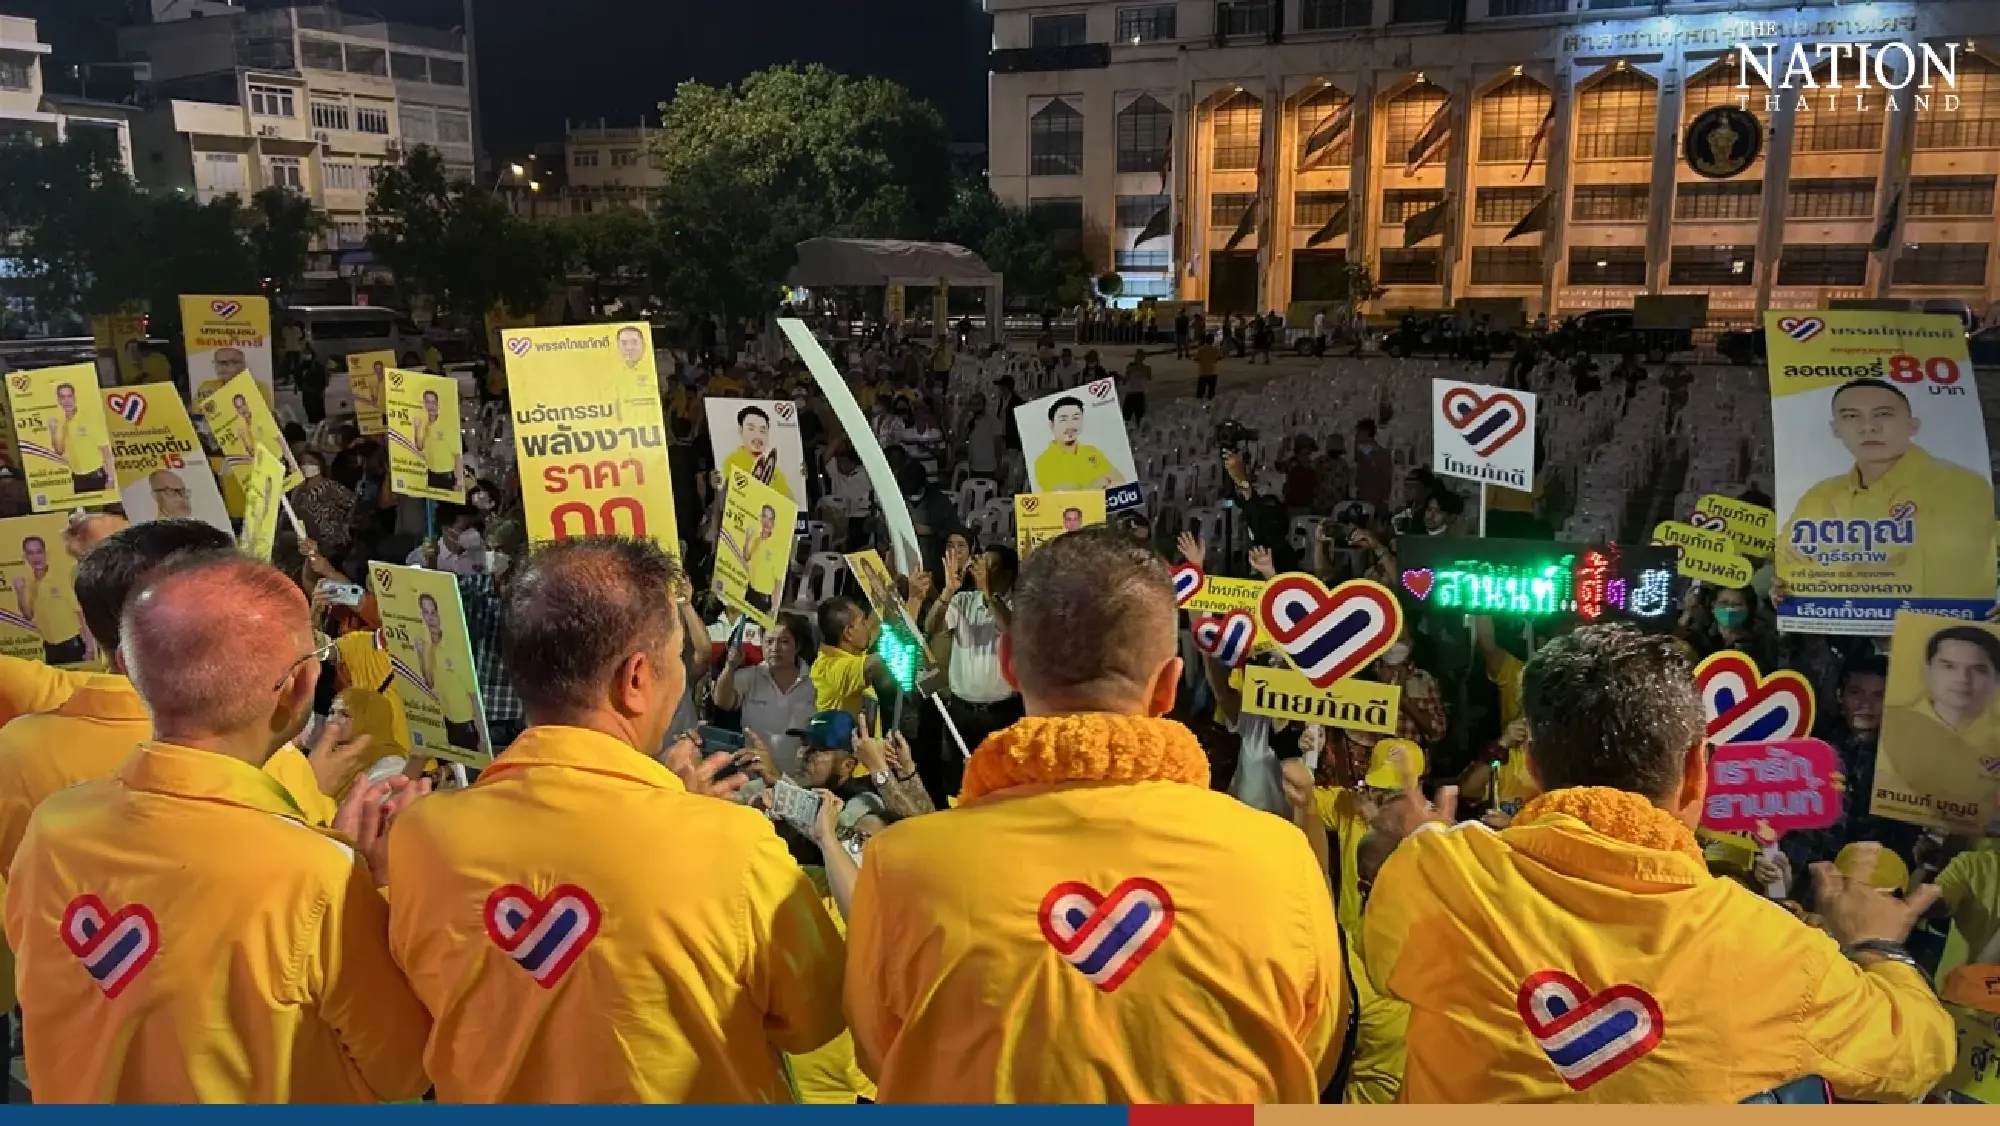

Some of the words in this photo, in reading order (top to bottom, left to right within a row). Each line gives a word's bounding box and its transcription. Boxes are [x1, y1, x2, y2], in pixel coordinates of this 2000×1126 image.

[535, 335, 610, 352] พรรคไทยภักดี
[1783, 356, 1884, 378] ลอตเตอรี่
[1888, 354, 1961, 384] 80
[1928, 385, 1966, 395] บาท
[516, 402, 613, 425] นวัตกรรม
[521, 424, 663, 457] พลังงาน
[161, 453, 186, 469] 15
[1441, 453, 1526, 487] ไทยภักดี
[543, 459, 646, 493] ราคา
[1708, 497, 1768, 529] ไทยภักดี
[1664, 524, 1726, 553] ไทยภักดี
[1726, 528, 1776, 553] บางพลั
[1685, 556, 1747, 582] บางพลัด
[1796, 600, 1892, 619] เลือกทั้งคน
[1251, 677, 1389, 727] ไทยภักดี
